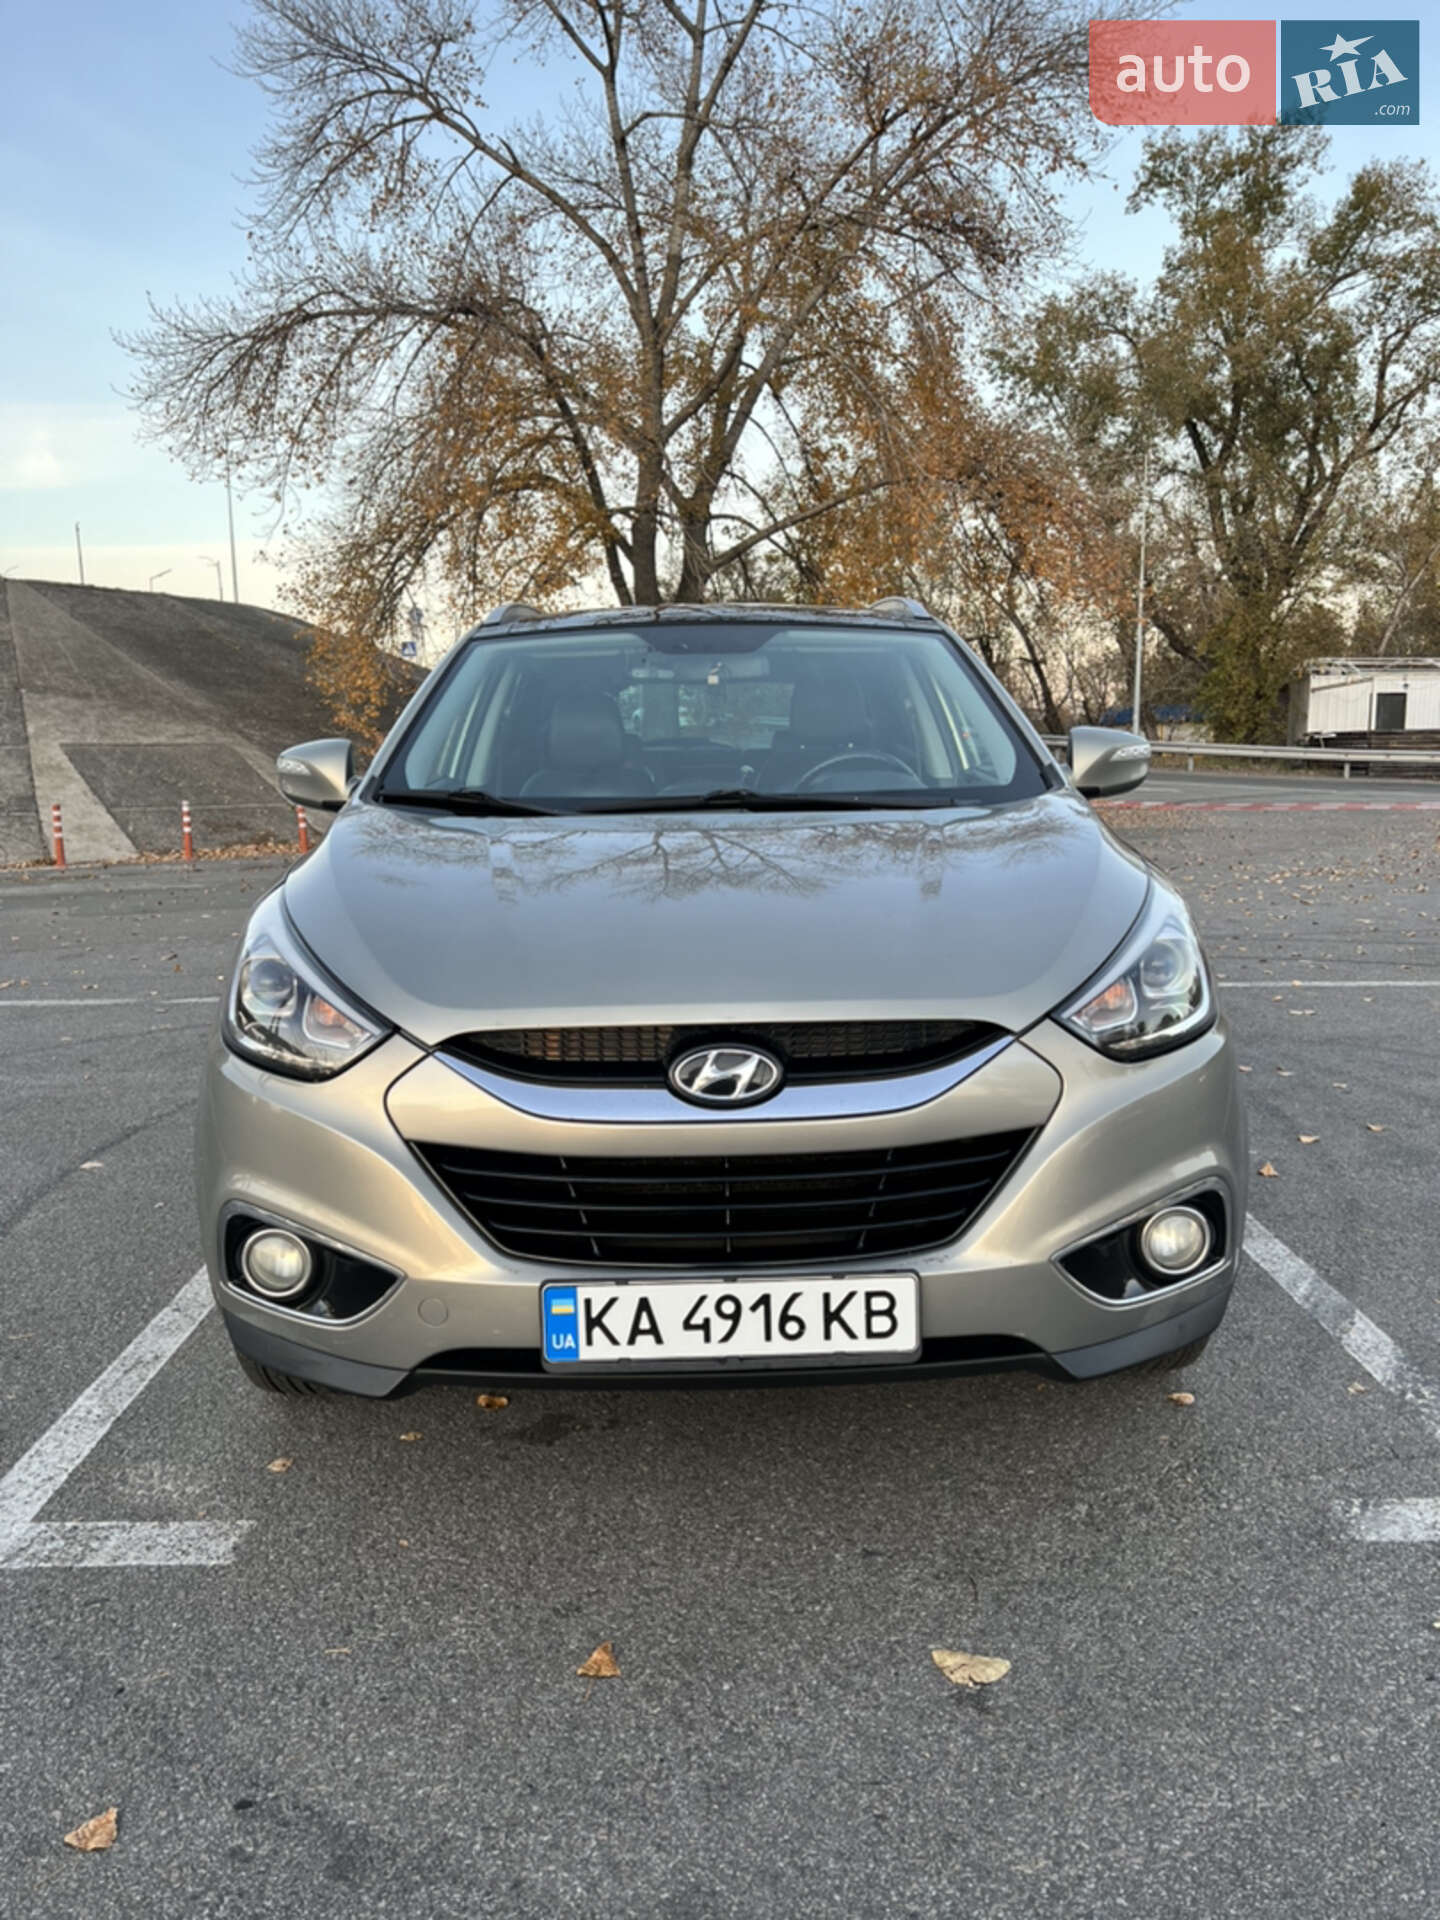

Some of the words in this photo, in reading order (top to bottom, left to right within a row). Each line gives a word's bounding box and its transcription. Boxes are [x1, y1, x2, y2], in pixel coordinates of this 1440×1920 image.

[583, 1296, 664, 1347] KA
[682, 1291, 806, 1344] 4916
[822, 1290, 898, 1342] KB
[551, 1333, 576, 1350] UA
